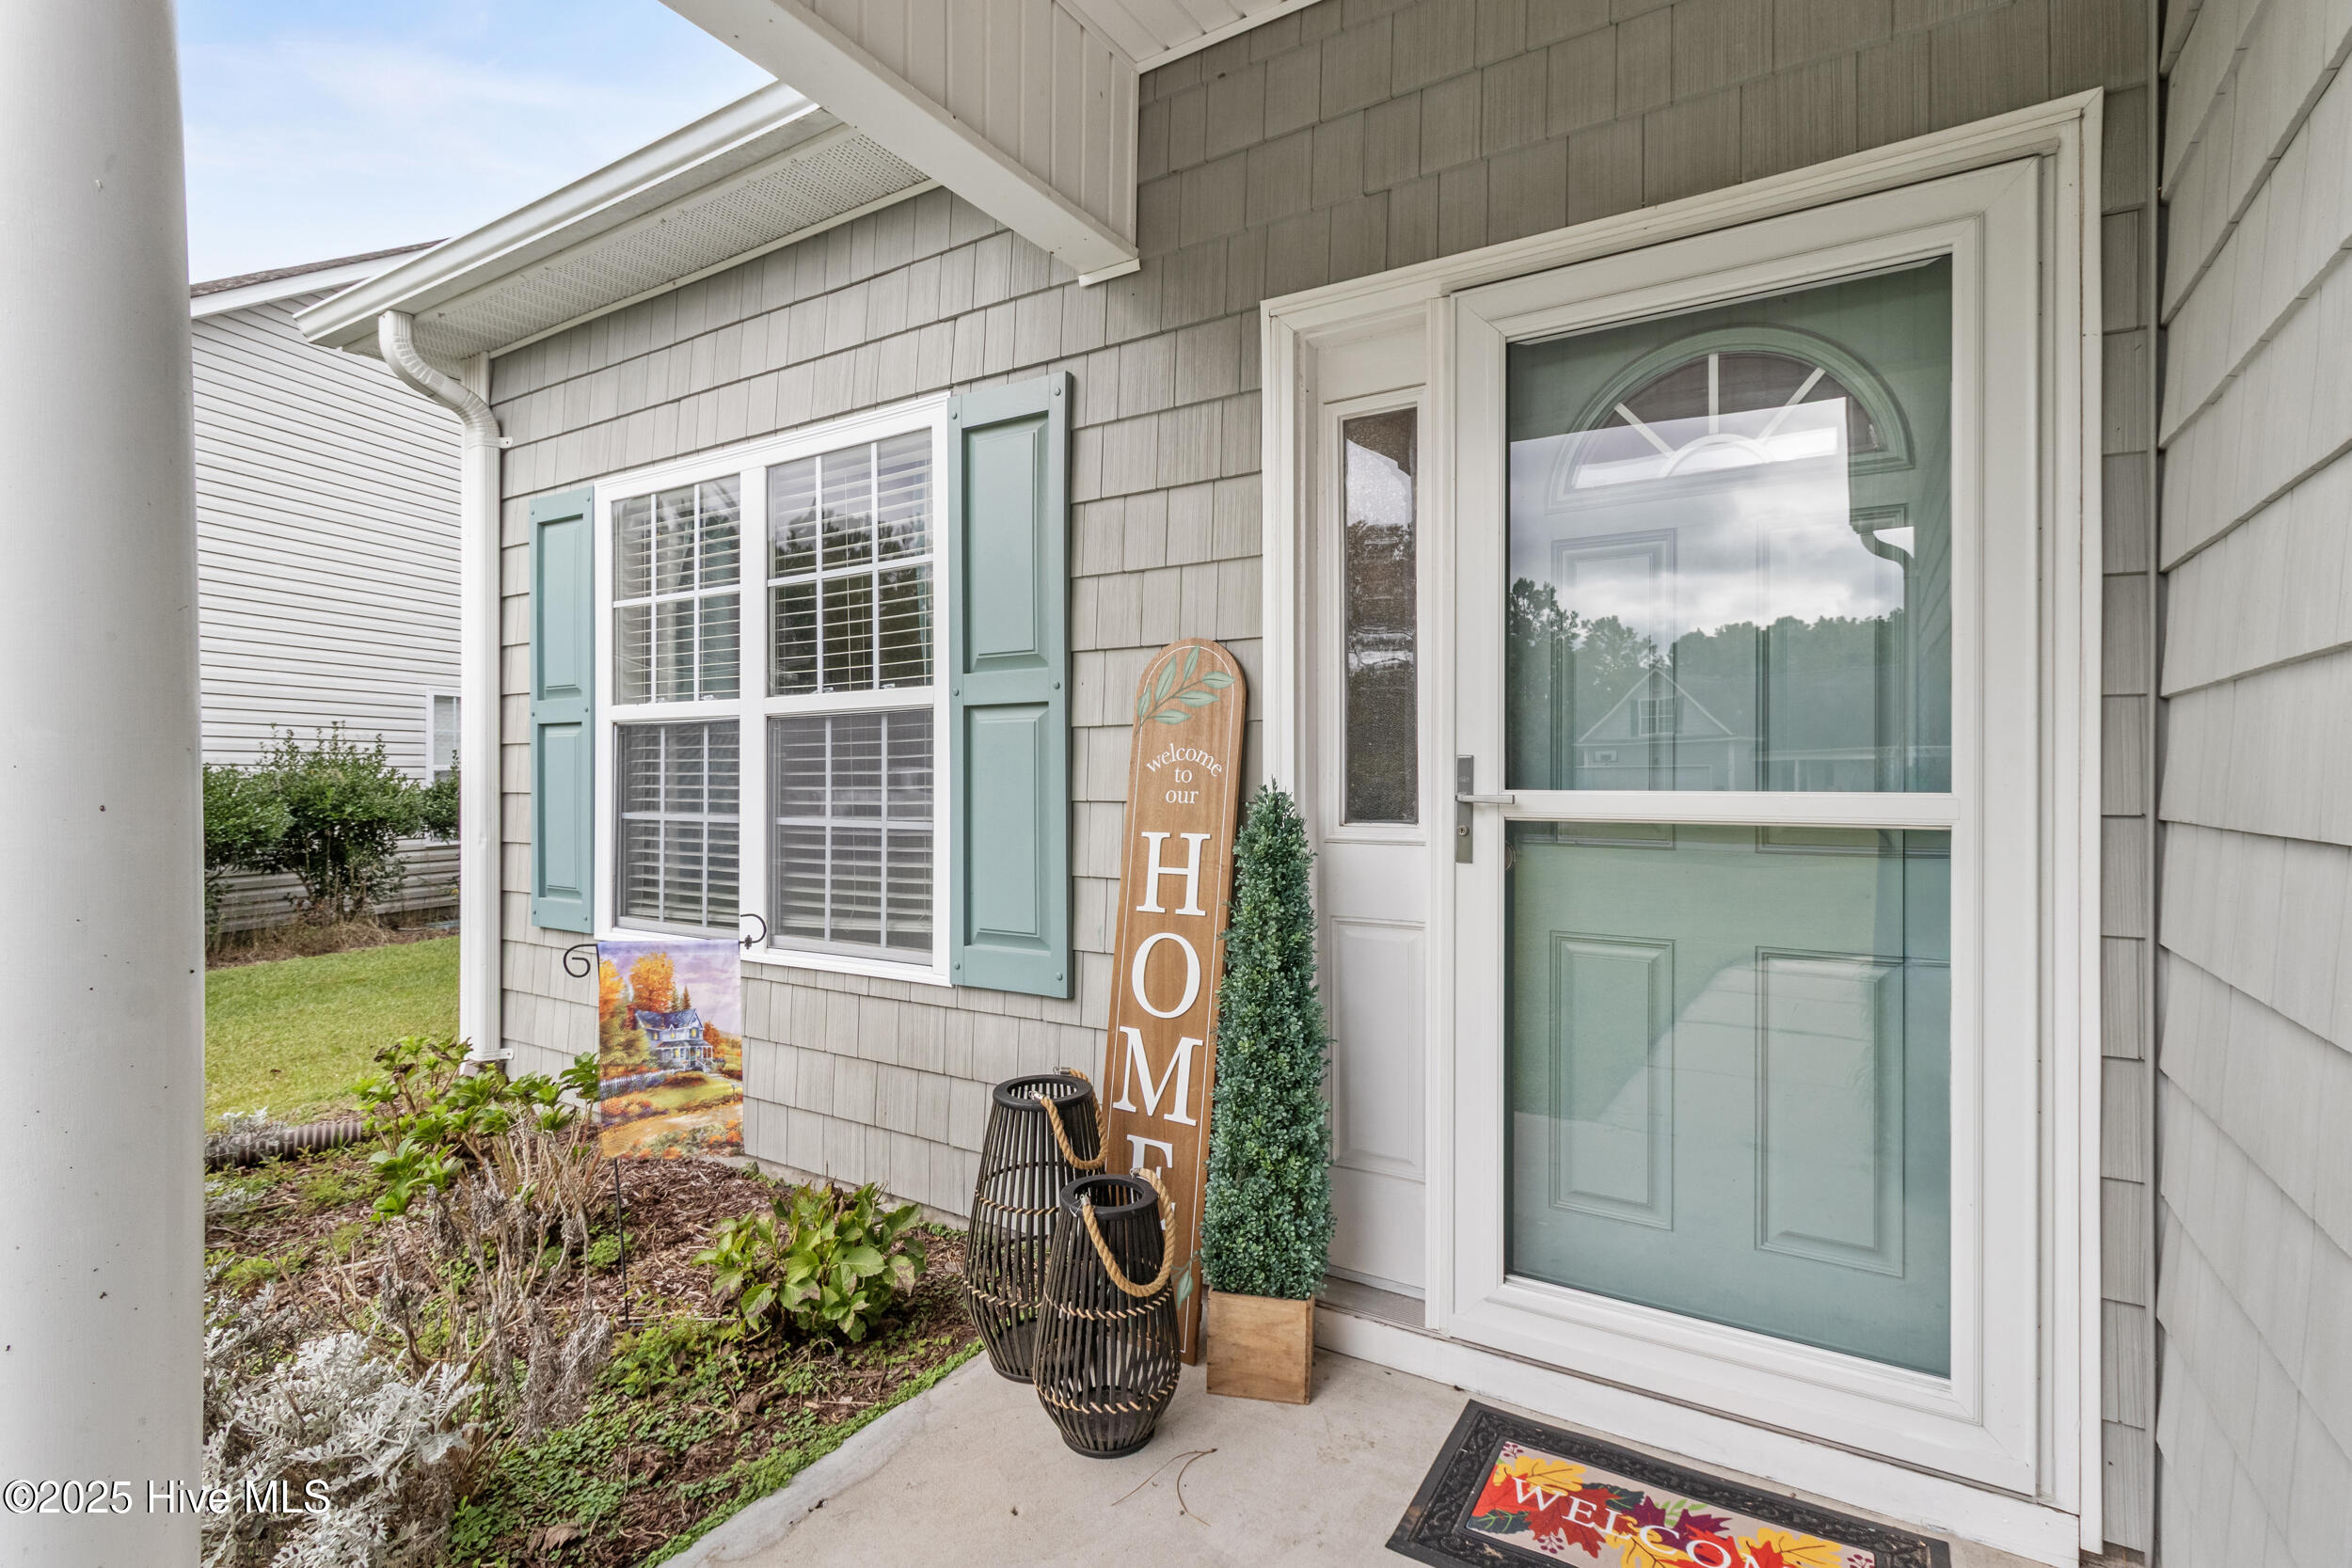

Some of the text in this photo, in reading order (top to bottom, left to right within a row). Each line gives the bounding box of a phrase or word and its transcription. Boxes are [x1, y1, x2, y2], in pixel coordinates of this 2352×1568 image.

[1146, 743, 1222, 777] welcome
[1174, 767, 1192, 784] to
[1166, 790, 1200, 804] our
